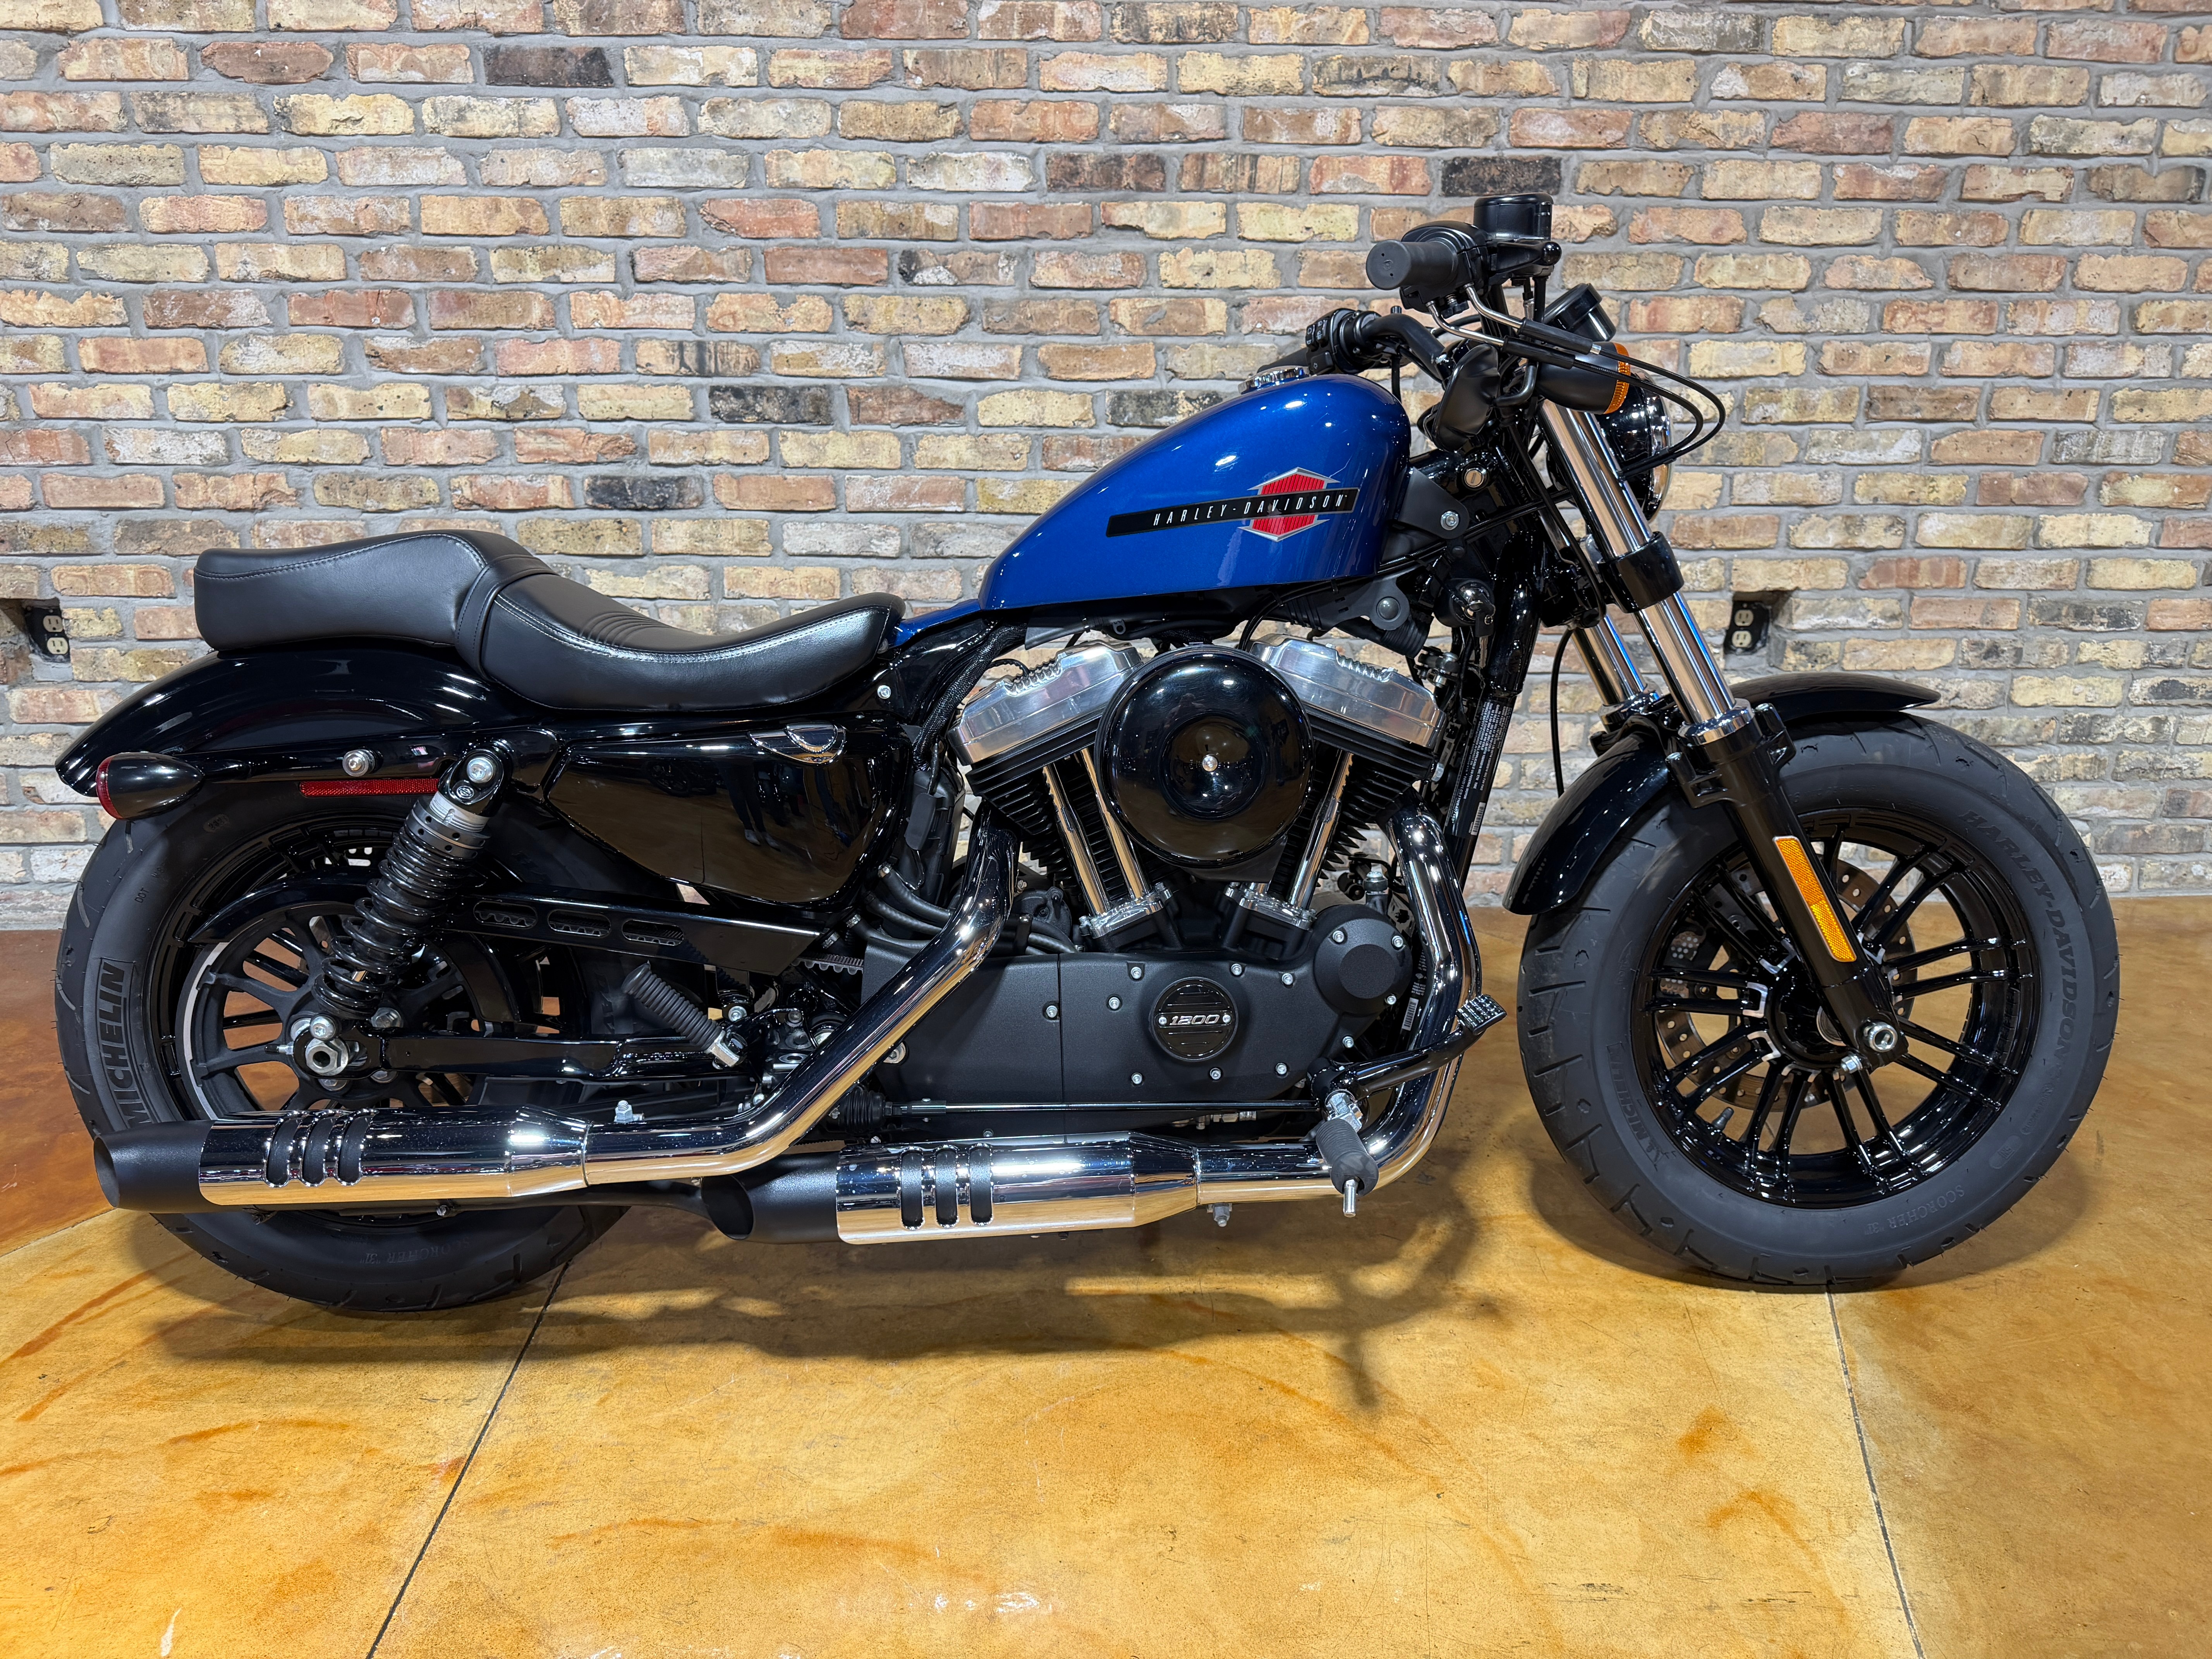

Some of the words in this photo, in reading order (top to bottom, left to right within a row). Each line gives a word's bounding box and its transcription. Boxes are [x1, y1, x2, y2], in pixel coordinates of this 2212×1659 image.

[1471, 750, 1479, 769] APPLICABLE
[134, 887, 149, 903] DOT
[1169, 1014, 1220, 1025] 1200
[98, 961, 153, 1128] MICHELIN
[1886, 1184, 1965, 1230] SCORCHER
